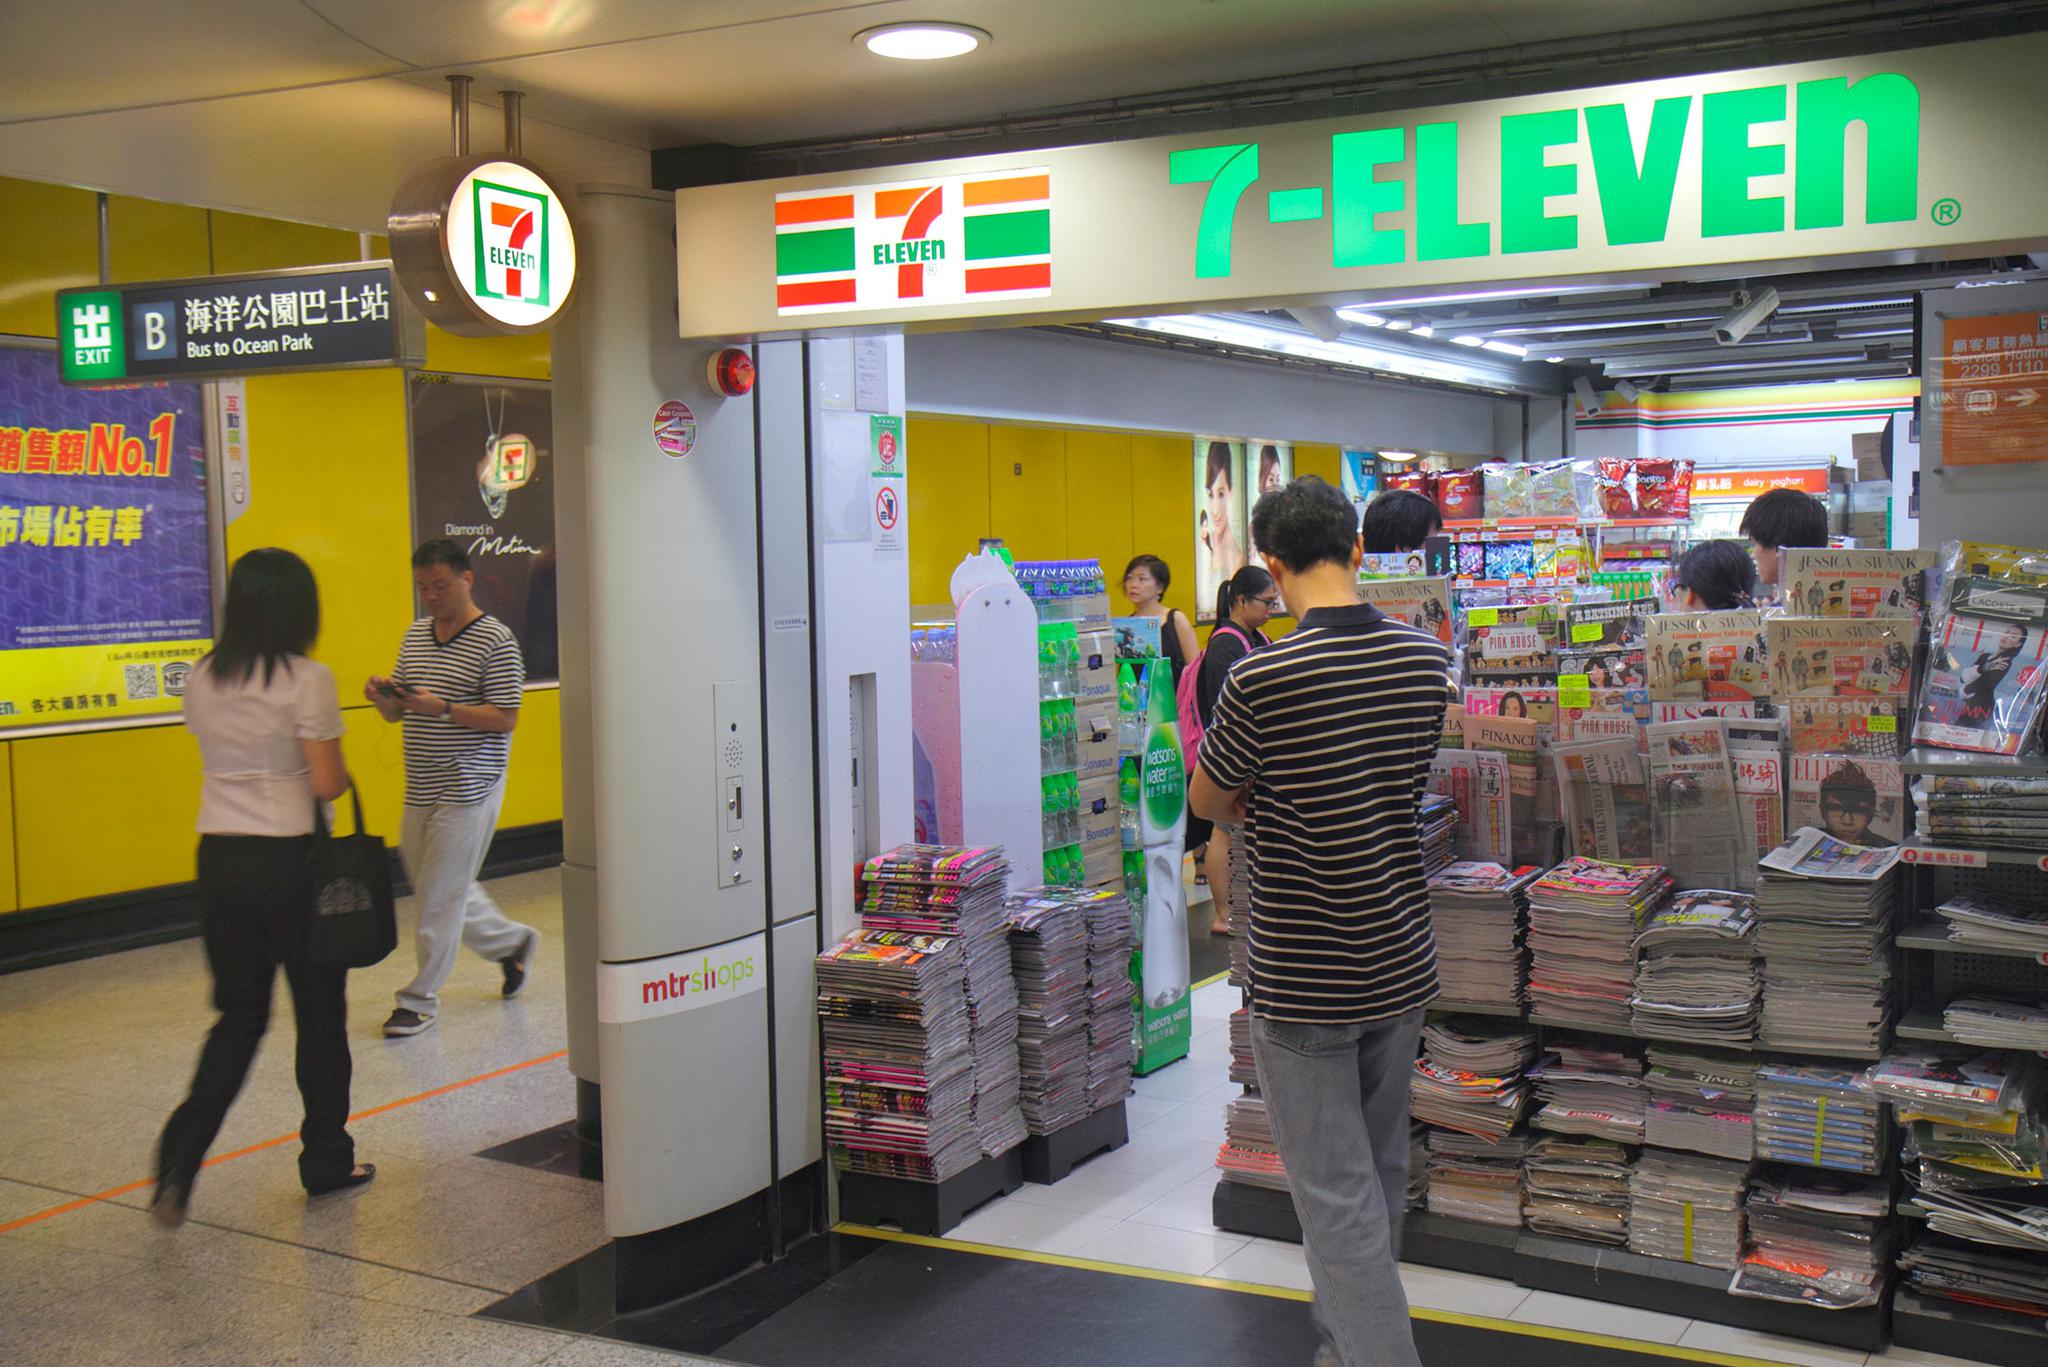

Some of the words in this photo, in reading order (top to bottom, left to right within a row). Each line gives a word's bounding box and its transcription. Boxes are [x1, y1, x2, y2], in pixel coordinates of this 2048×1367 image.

[185, 283, 389, 335] 海洋公園巴士站
[73, 304, 112, 349] 出
[145, 312, 167, 351] B
[187, 341, 211, 359] Bus
[214, 343, 230, 357] to
[232, 337, 277, 355] Ocean
[281, 333, 313, 352] Park
[75, 349, 112, 366] EXIT
[1961, 363, 2000, 379] 2299
[2007, 360, 2043, 376] 1110
[1743, 478, 1764, 489] dairy
[446, 524, 484, 535] Diamond
[485, 524, 493, 535] in
[1510, 634, 1537, 649] HOUSE
[1481, 729, 1537, 746] FINANCI
